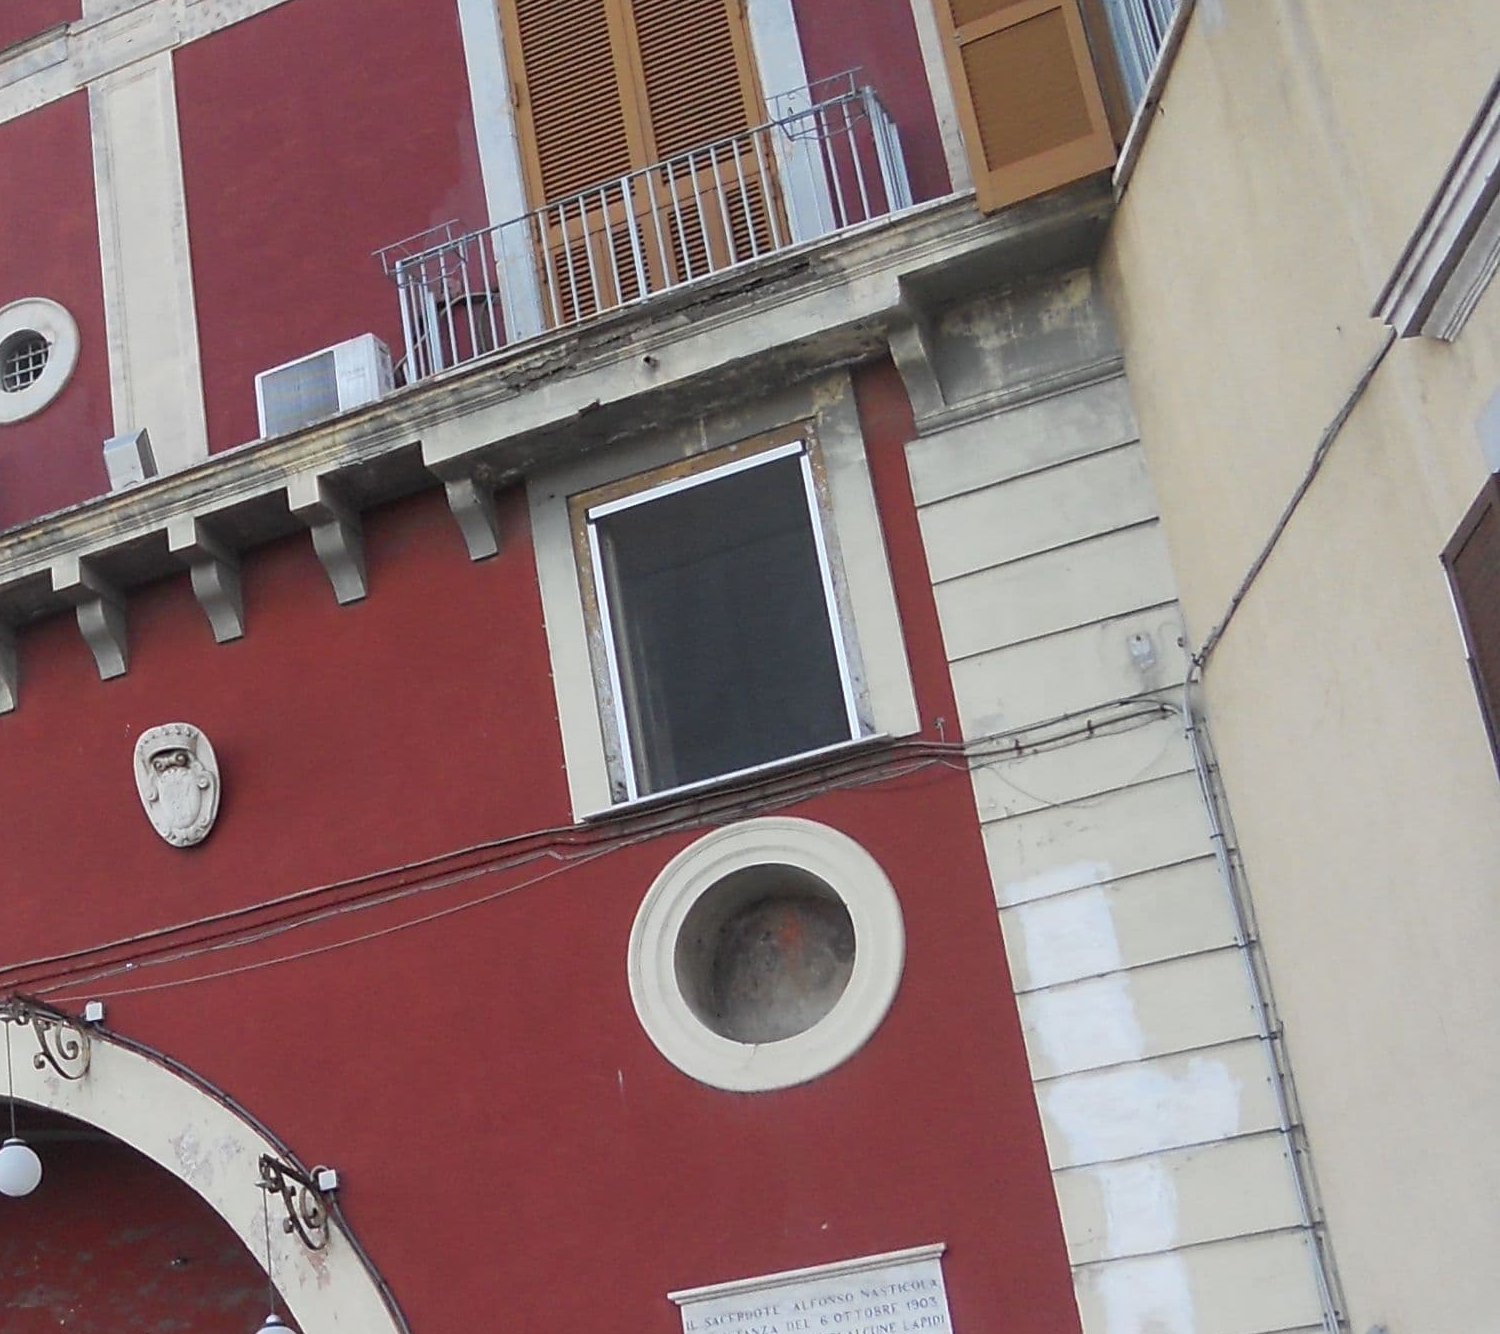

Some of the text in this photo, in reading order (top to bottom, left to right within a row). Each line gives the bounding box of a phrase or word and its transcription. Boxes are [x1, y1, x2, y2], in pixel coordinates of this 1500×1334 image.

[820, 1316, 828, 1325] 6
[905, 1296, 937, 1310] 1903
[902, 1314, 945, 1330] LAPIDI
